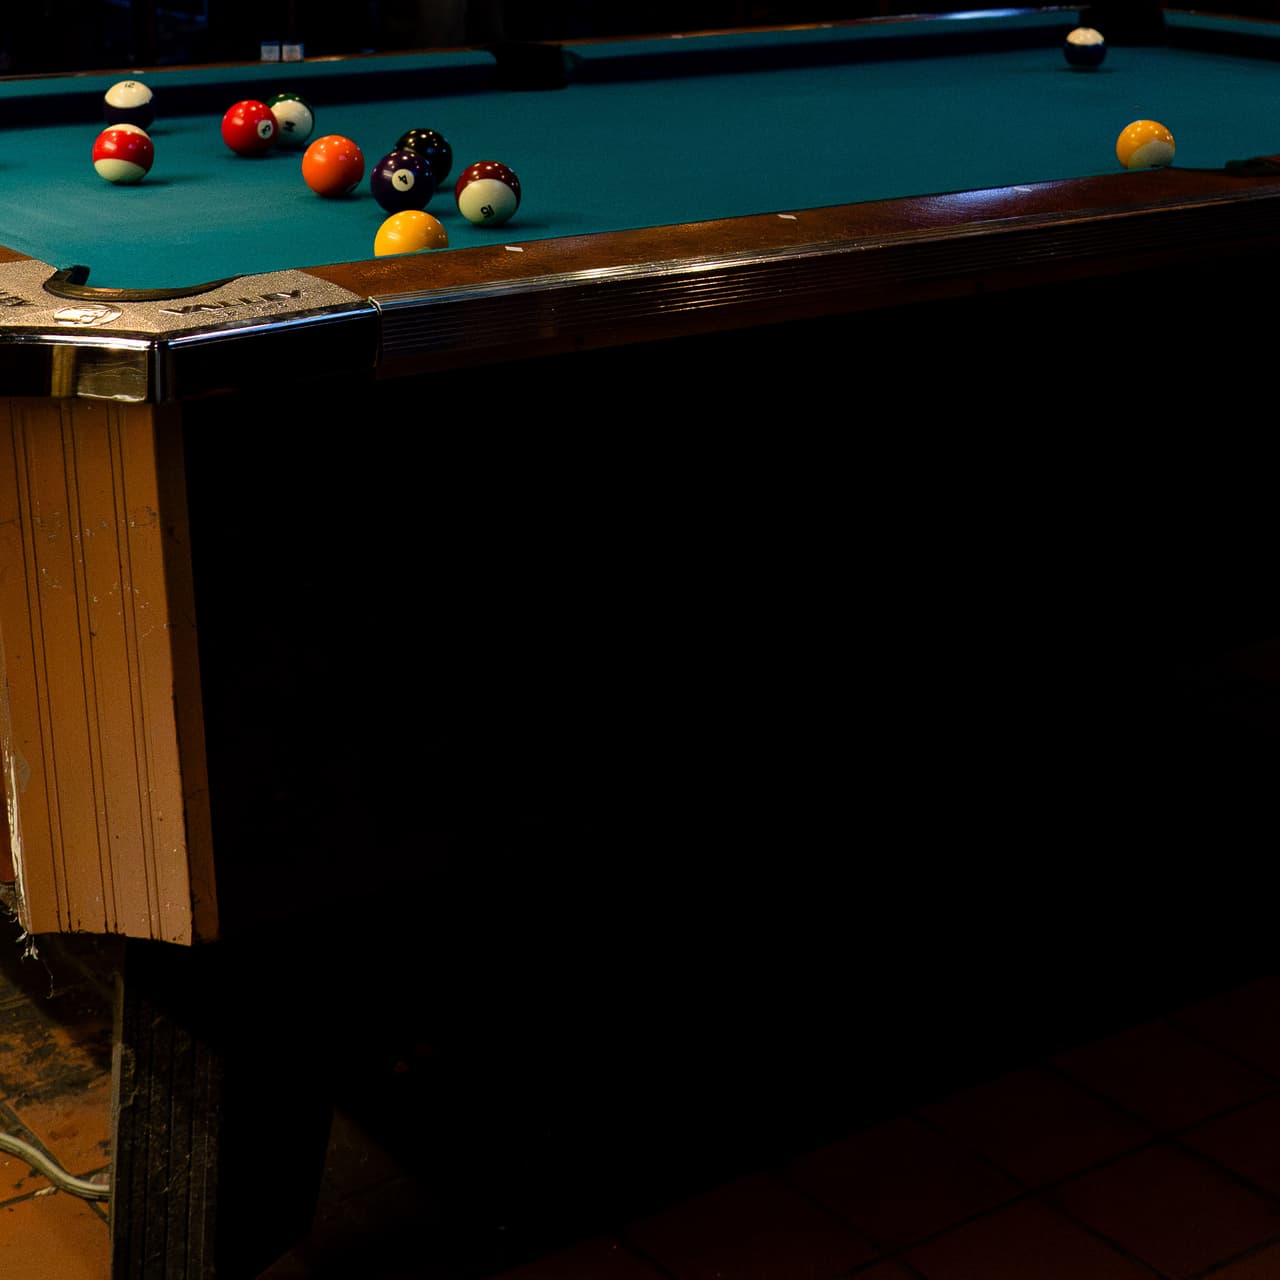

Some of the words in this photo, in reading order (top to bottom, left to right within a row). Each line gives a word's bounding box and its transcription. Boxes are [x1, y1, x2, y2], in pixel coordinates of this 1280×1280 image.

[398, 174, 409, 185] 4
[480, 204, 496, 219] 15
[159, 288, 302, 316] VALLEY
